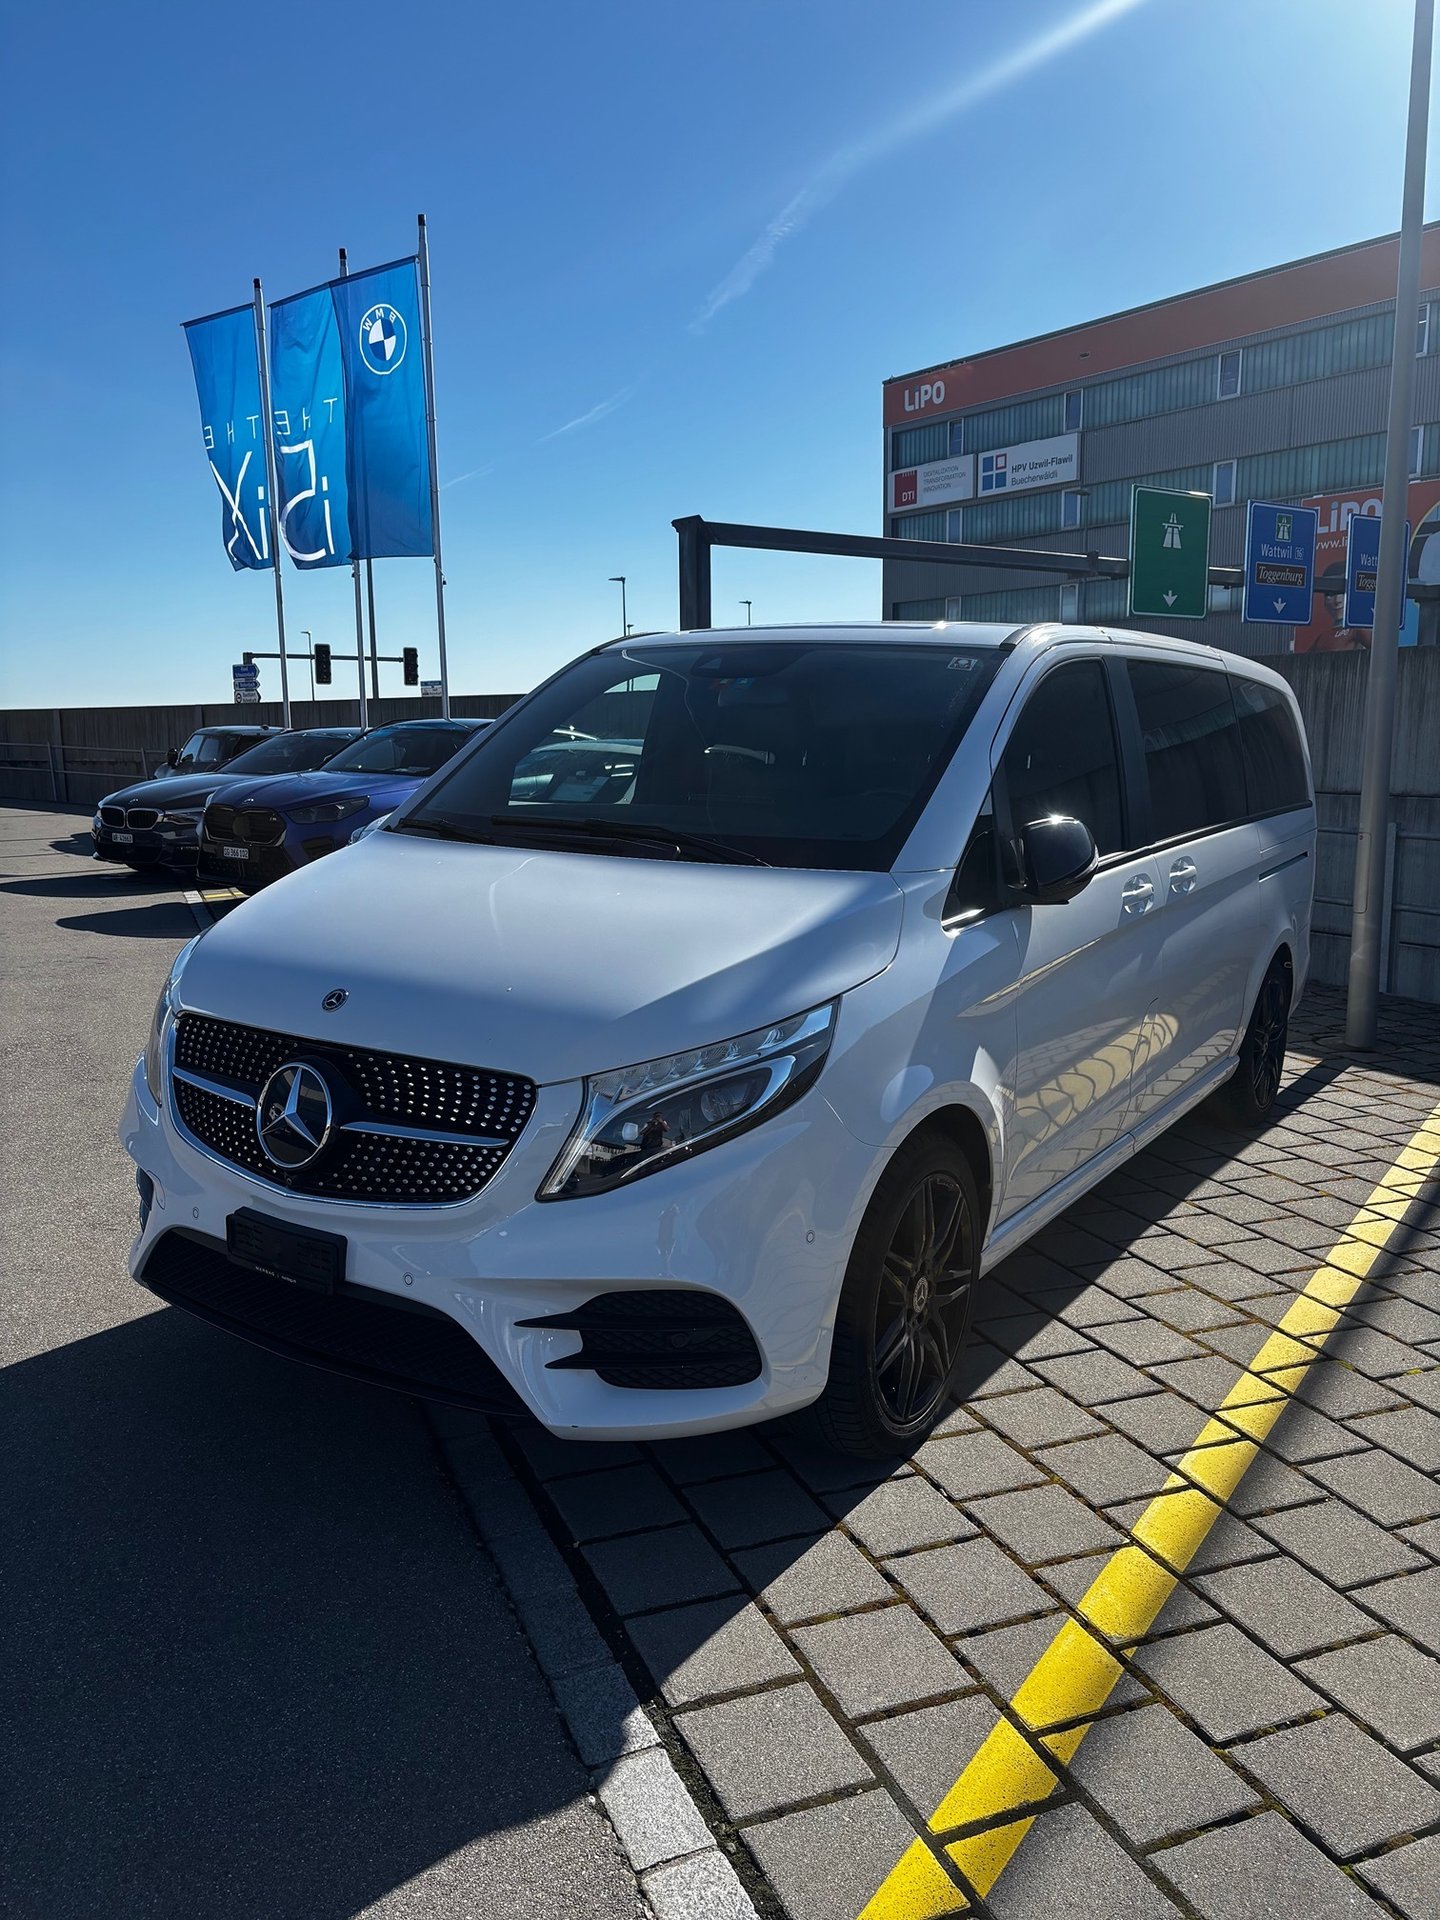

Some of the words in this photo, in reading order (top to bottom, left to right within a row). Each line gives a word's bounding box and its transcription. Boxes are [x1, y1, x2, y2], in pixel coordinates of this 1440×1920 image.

[1011, 462, 1027, 474] HPV
[1029, 454, 1073, 471] Uzwil-Flawil
[923, 472, 966, 485] TRANSFORMATION
[902, 490, 915, 502] DTI
[1261, 543, 1292, 559] Wattwil
[1360, 553, 1378, 567] Watt
[1259, 566, 1304, 585] Toggenburg
[1358, 574, 1377, 590] Togg
